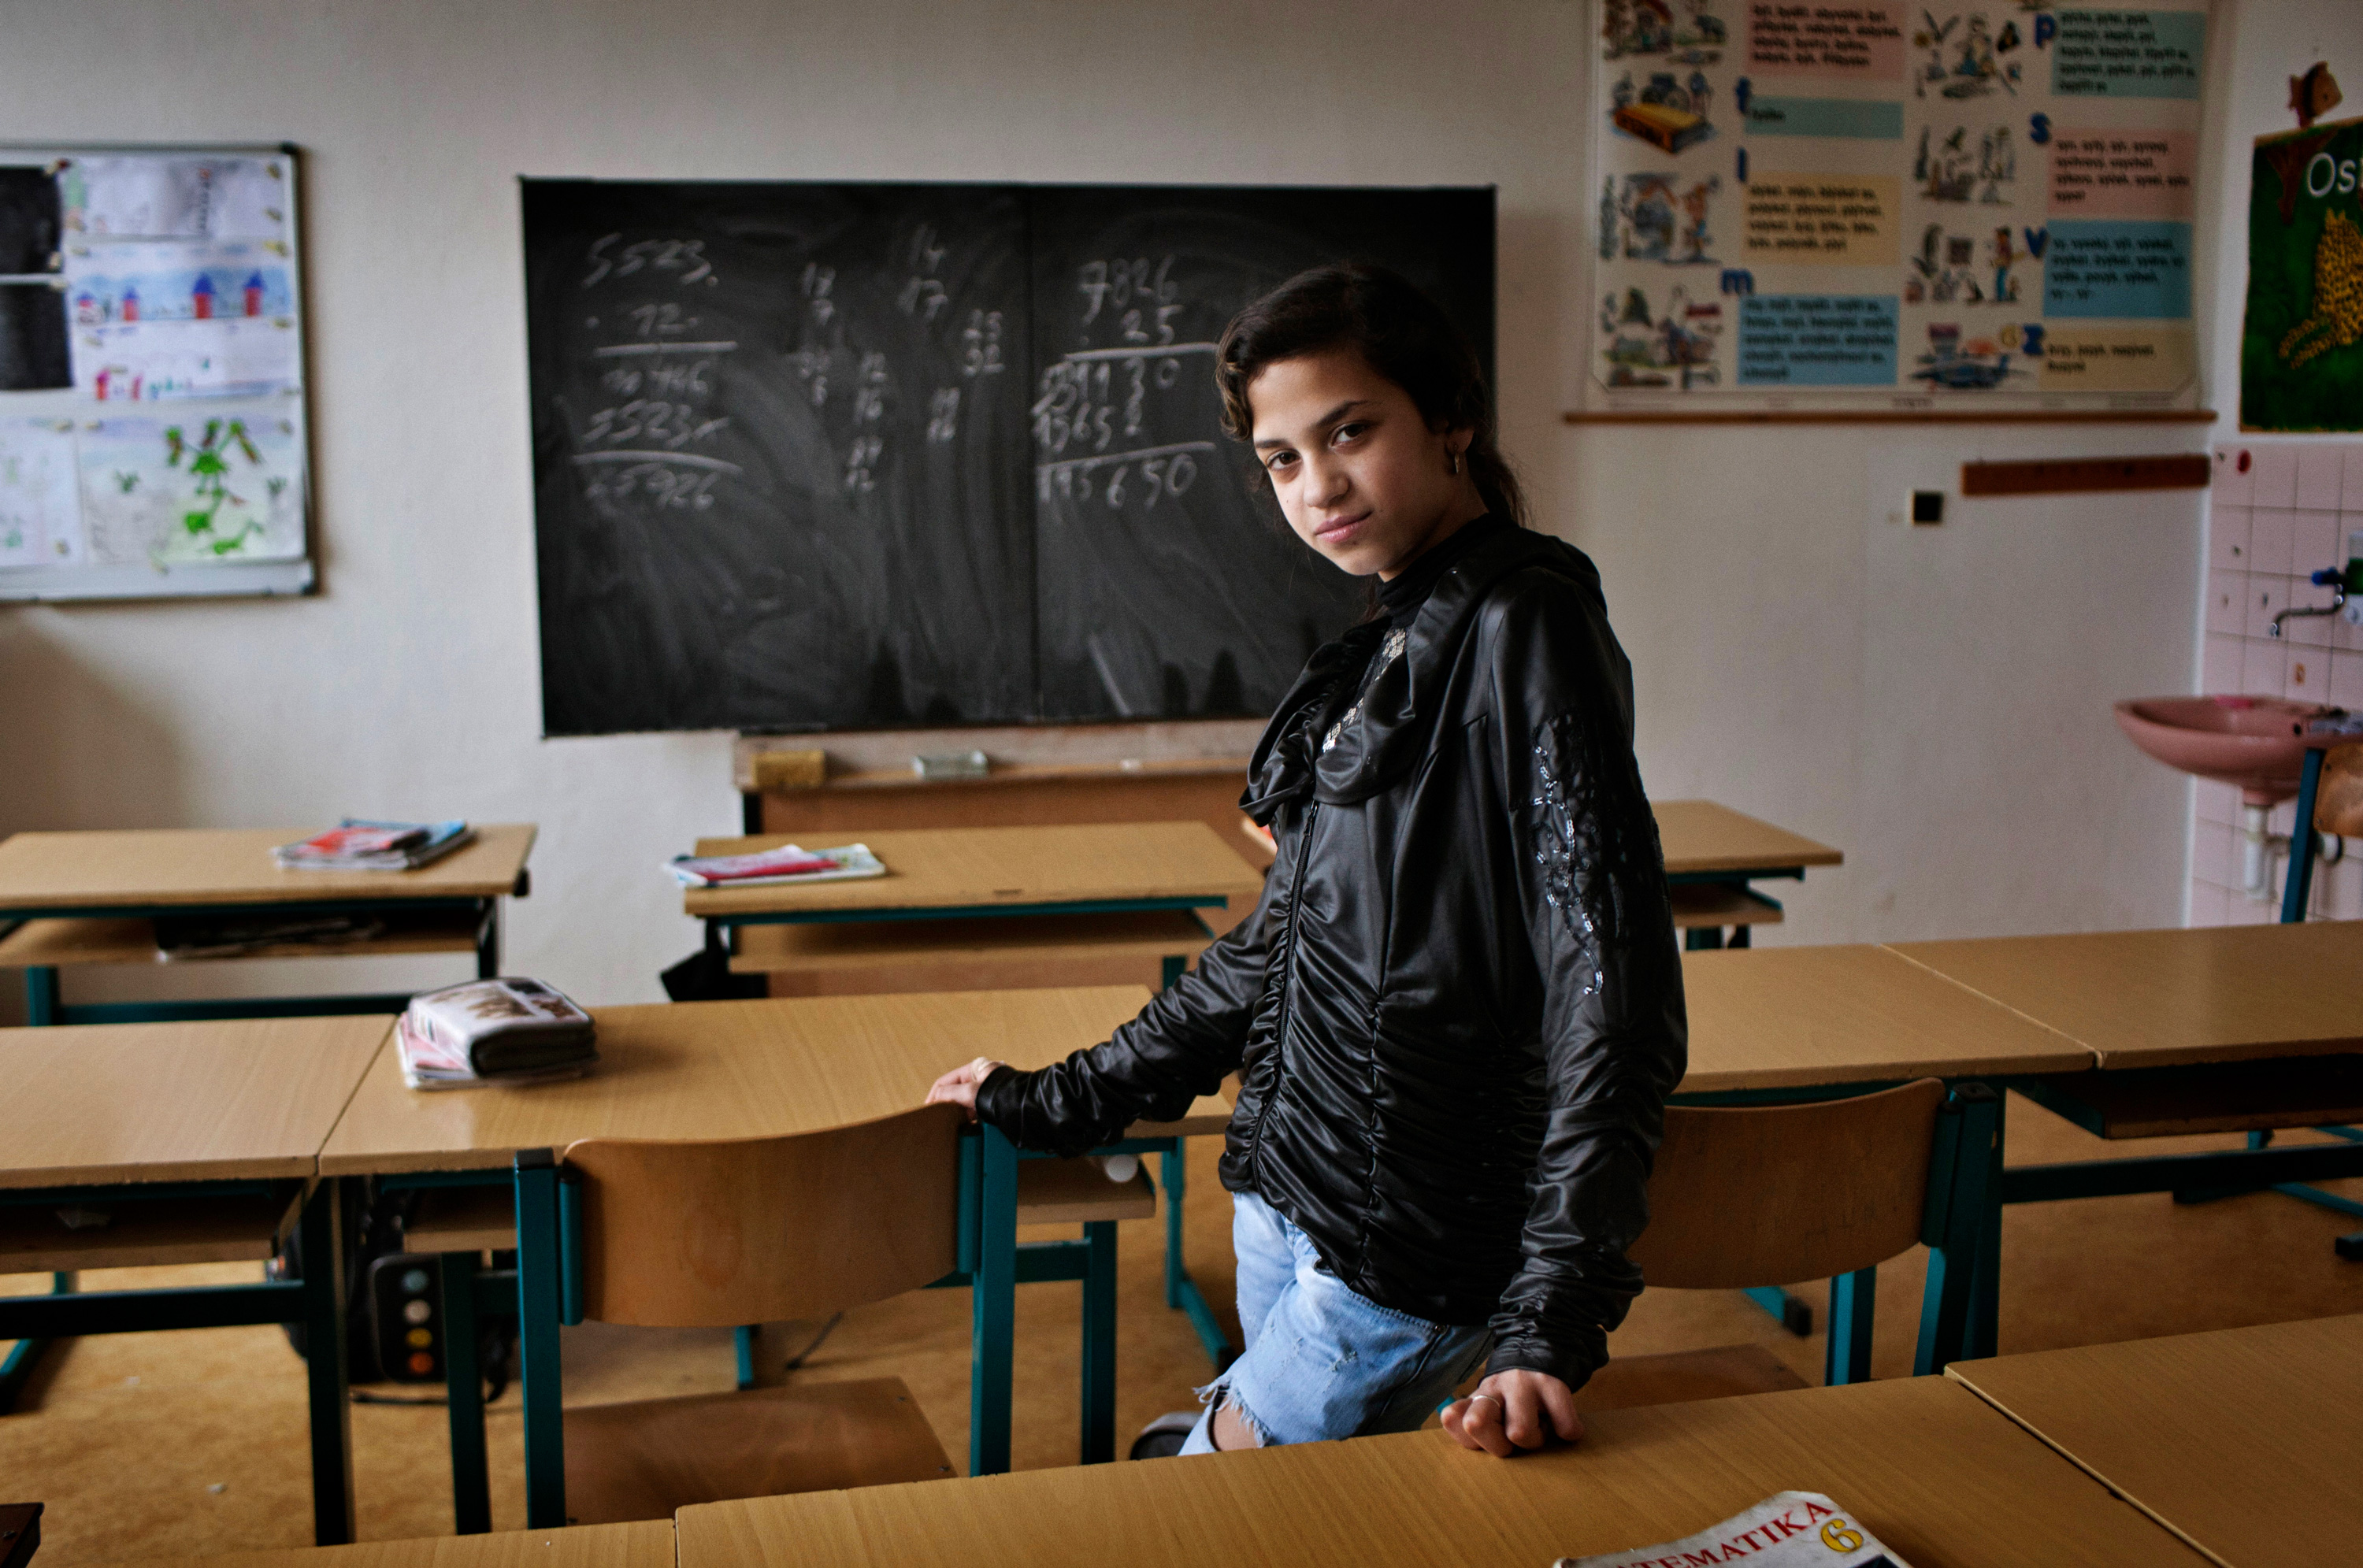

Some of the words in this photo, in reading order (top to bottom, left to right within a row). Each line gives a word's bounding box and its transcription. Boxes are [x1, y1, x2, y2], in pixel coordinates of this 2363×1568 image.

[2306, 151, 2363, 198] Os
[1617, 1501, 1834, 1568] TEMATIKA
[1820, 1518, 1864, 1553] 6
